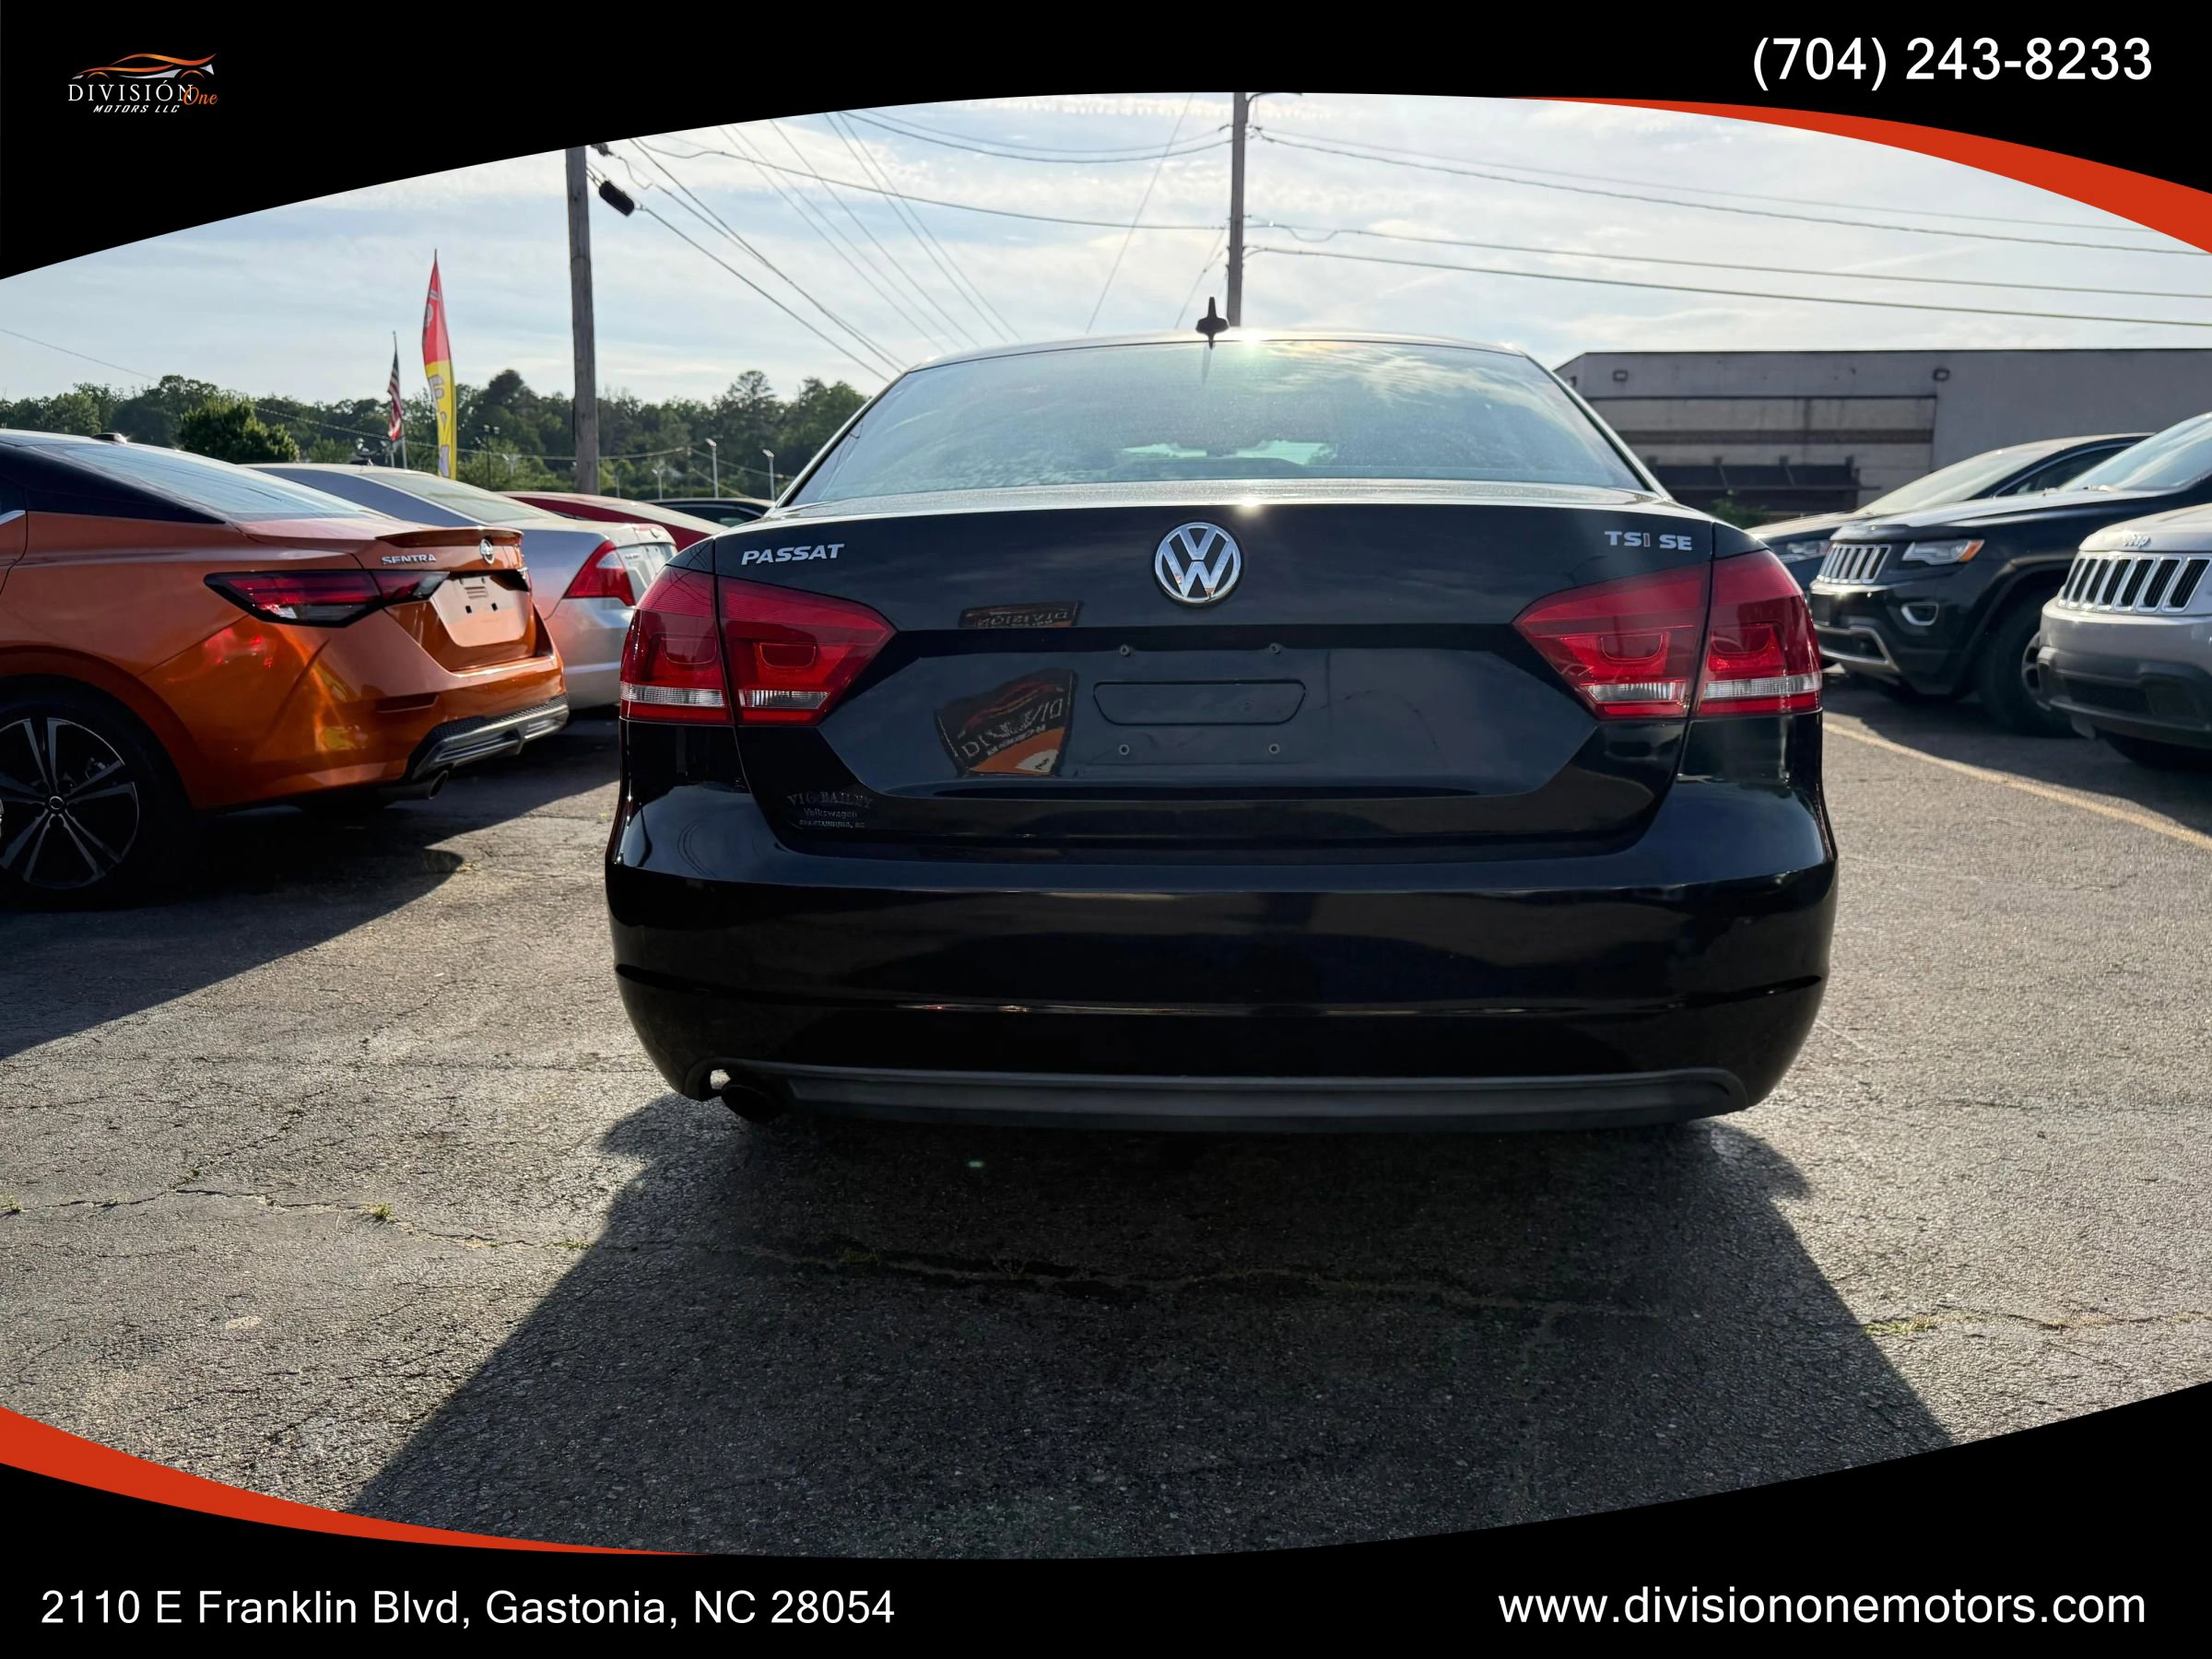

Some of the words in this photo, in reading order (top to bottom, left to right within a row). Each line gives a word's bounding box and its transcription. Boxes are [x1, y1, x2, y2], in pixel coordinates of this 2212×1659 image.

[1605, 530, 1651, 547] TSI
[1659, 534, 1692, 551] SE
[382, 554, 437, 565] SENTRA
[741, 543, 845, 566] PASSAT
